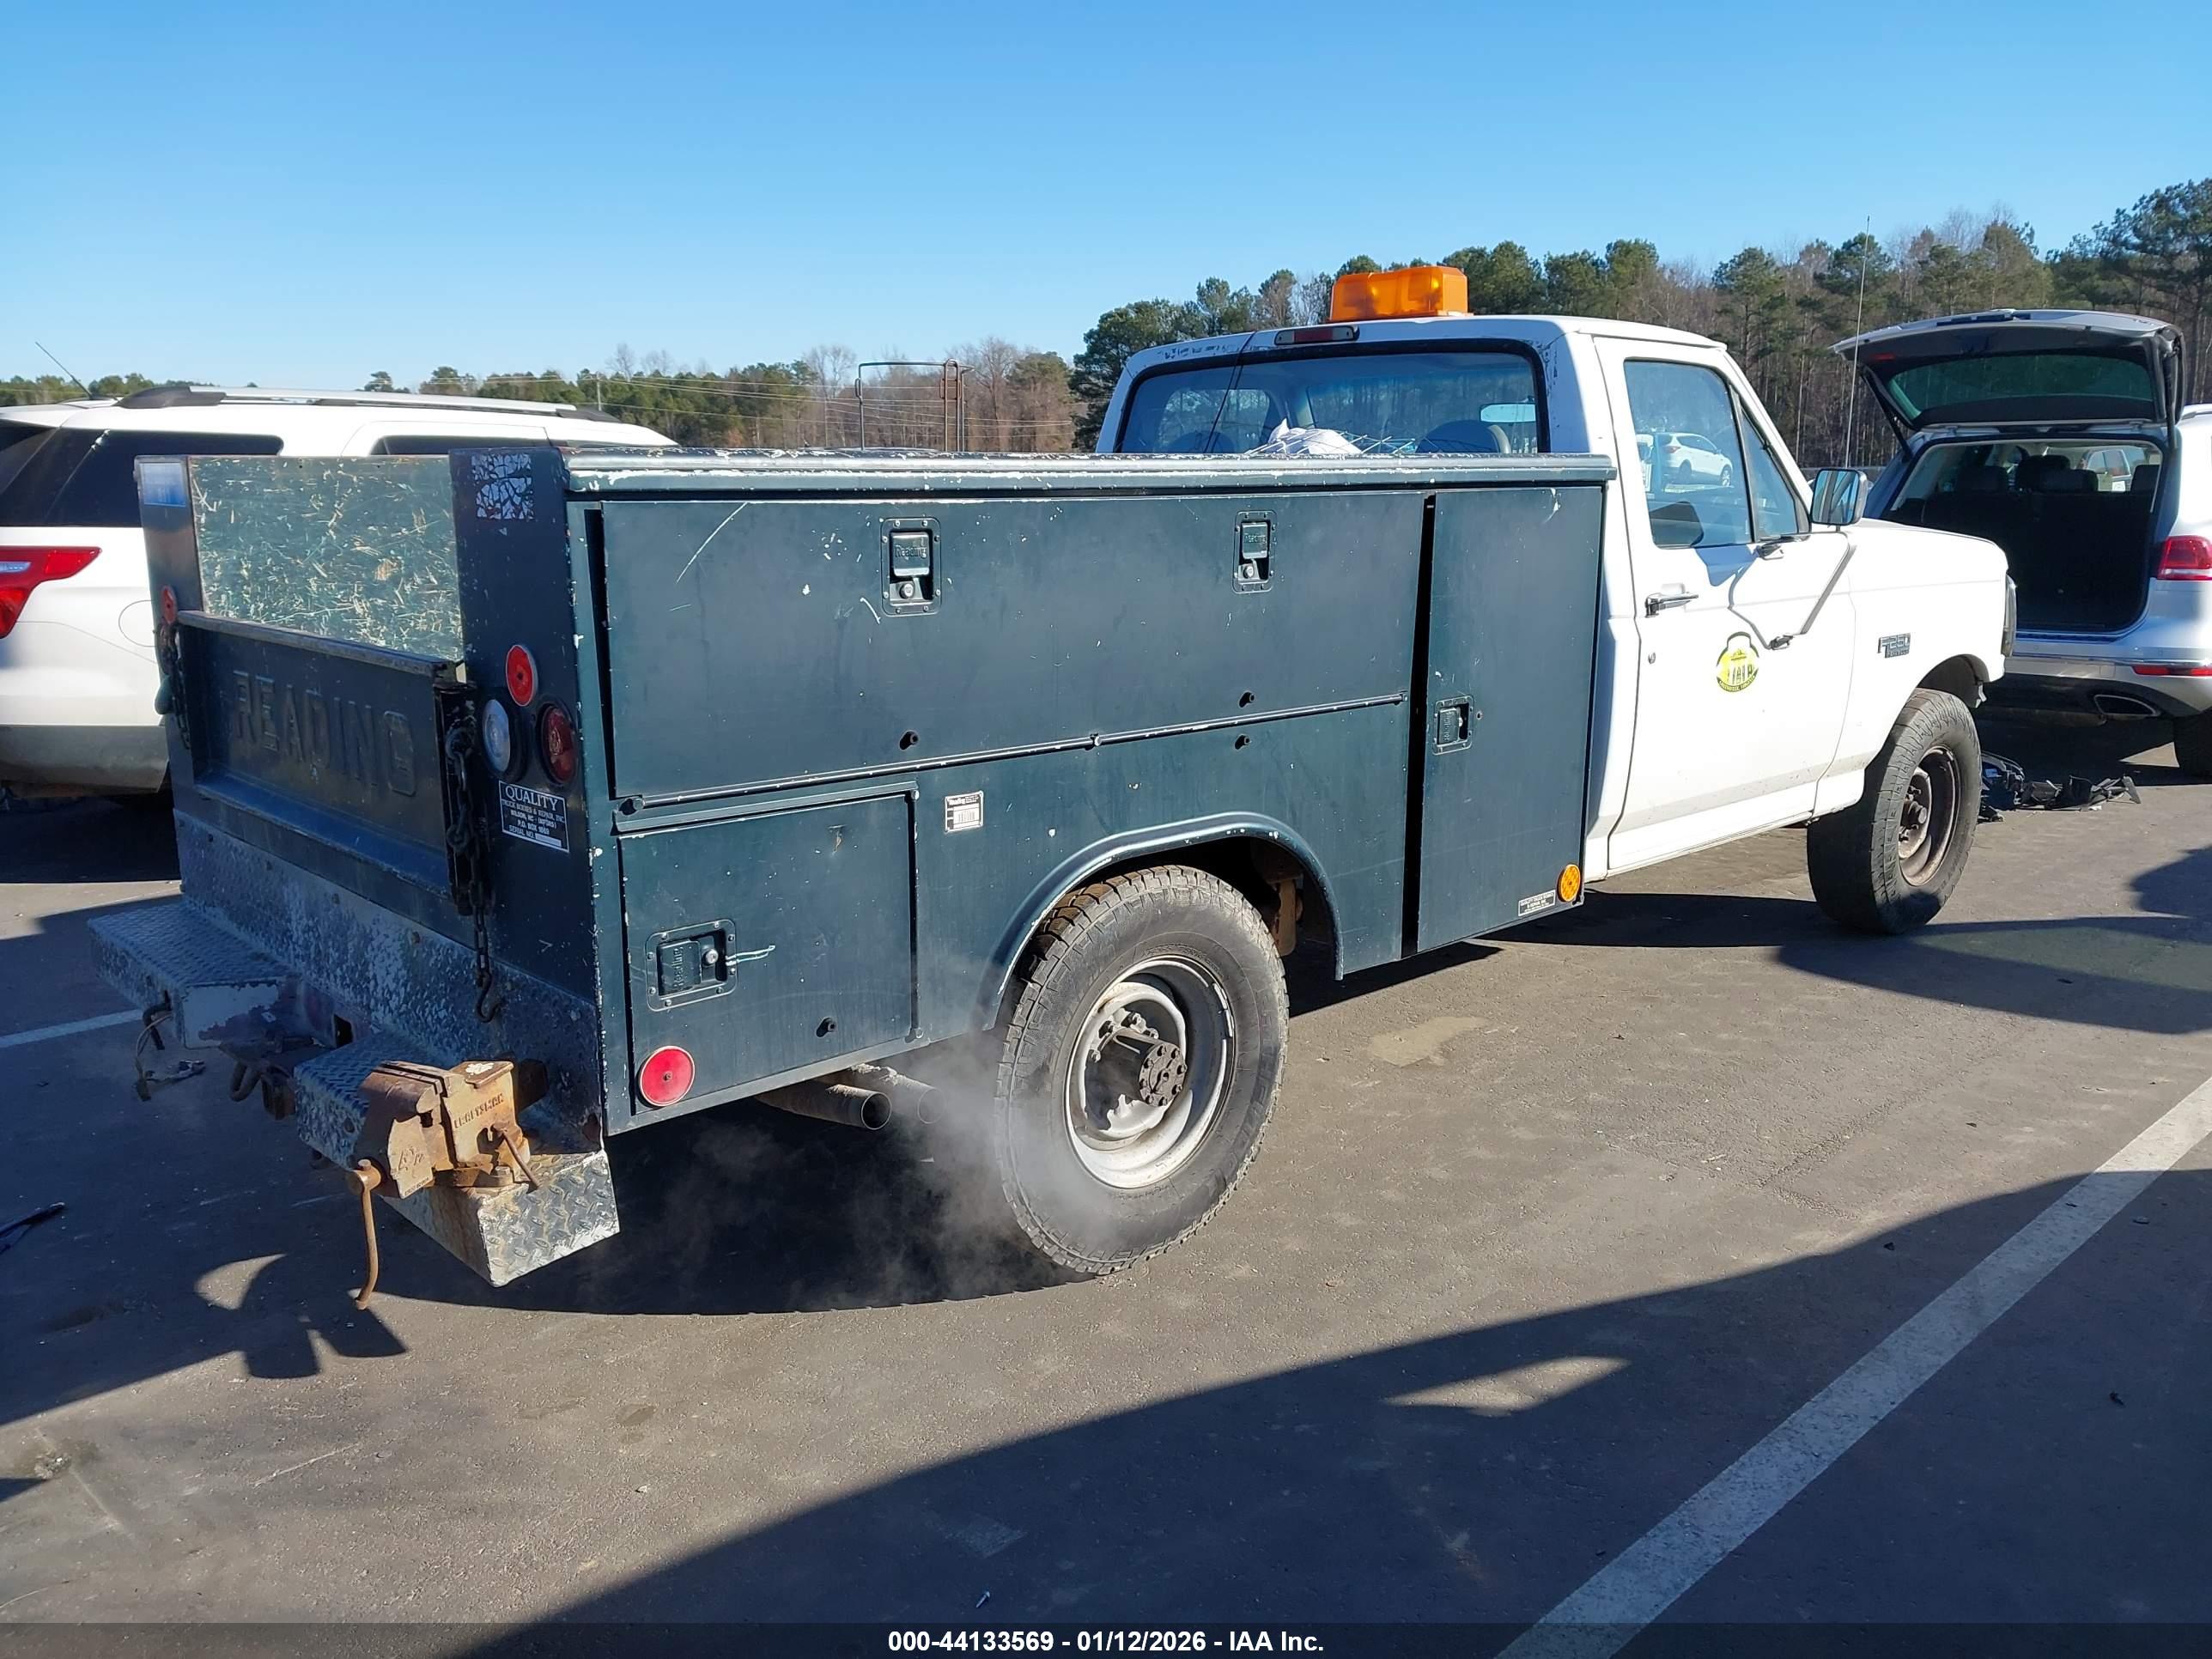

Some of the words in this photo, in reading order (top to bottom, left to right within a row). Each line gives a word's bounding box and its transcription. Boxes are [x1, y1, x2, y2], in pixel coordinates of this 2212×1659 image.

[895, 544, 927, 558] Reading
[233, 669, 416, 798] READING
[505, 786, 558, 811] QUALITY
[508, 824, 525, 836] SERIAL
[527, 823, 537, 831] BOX
